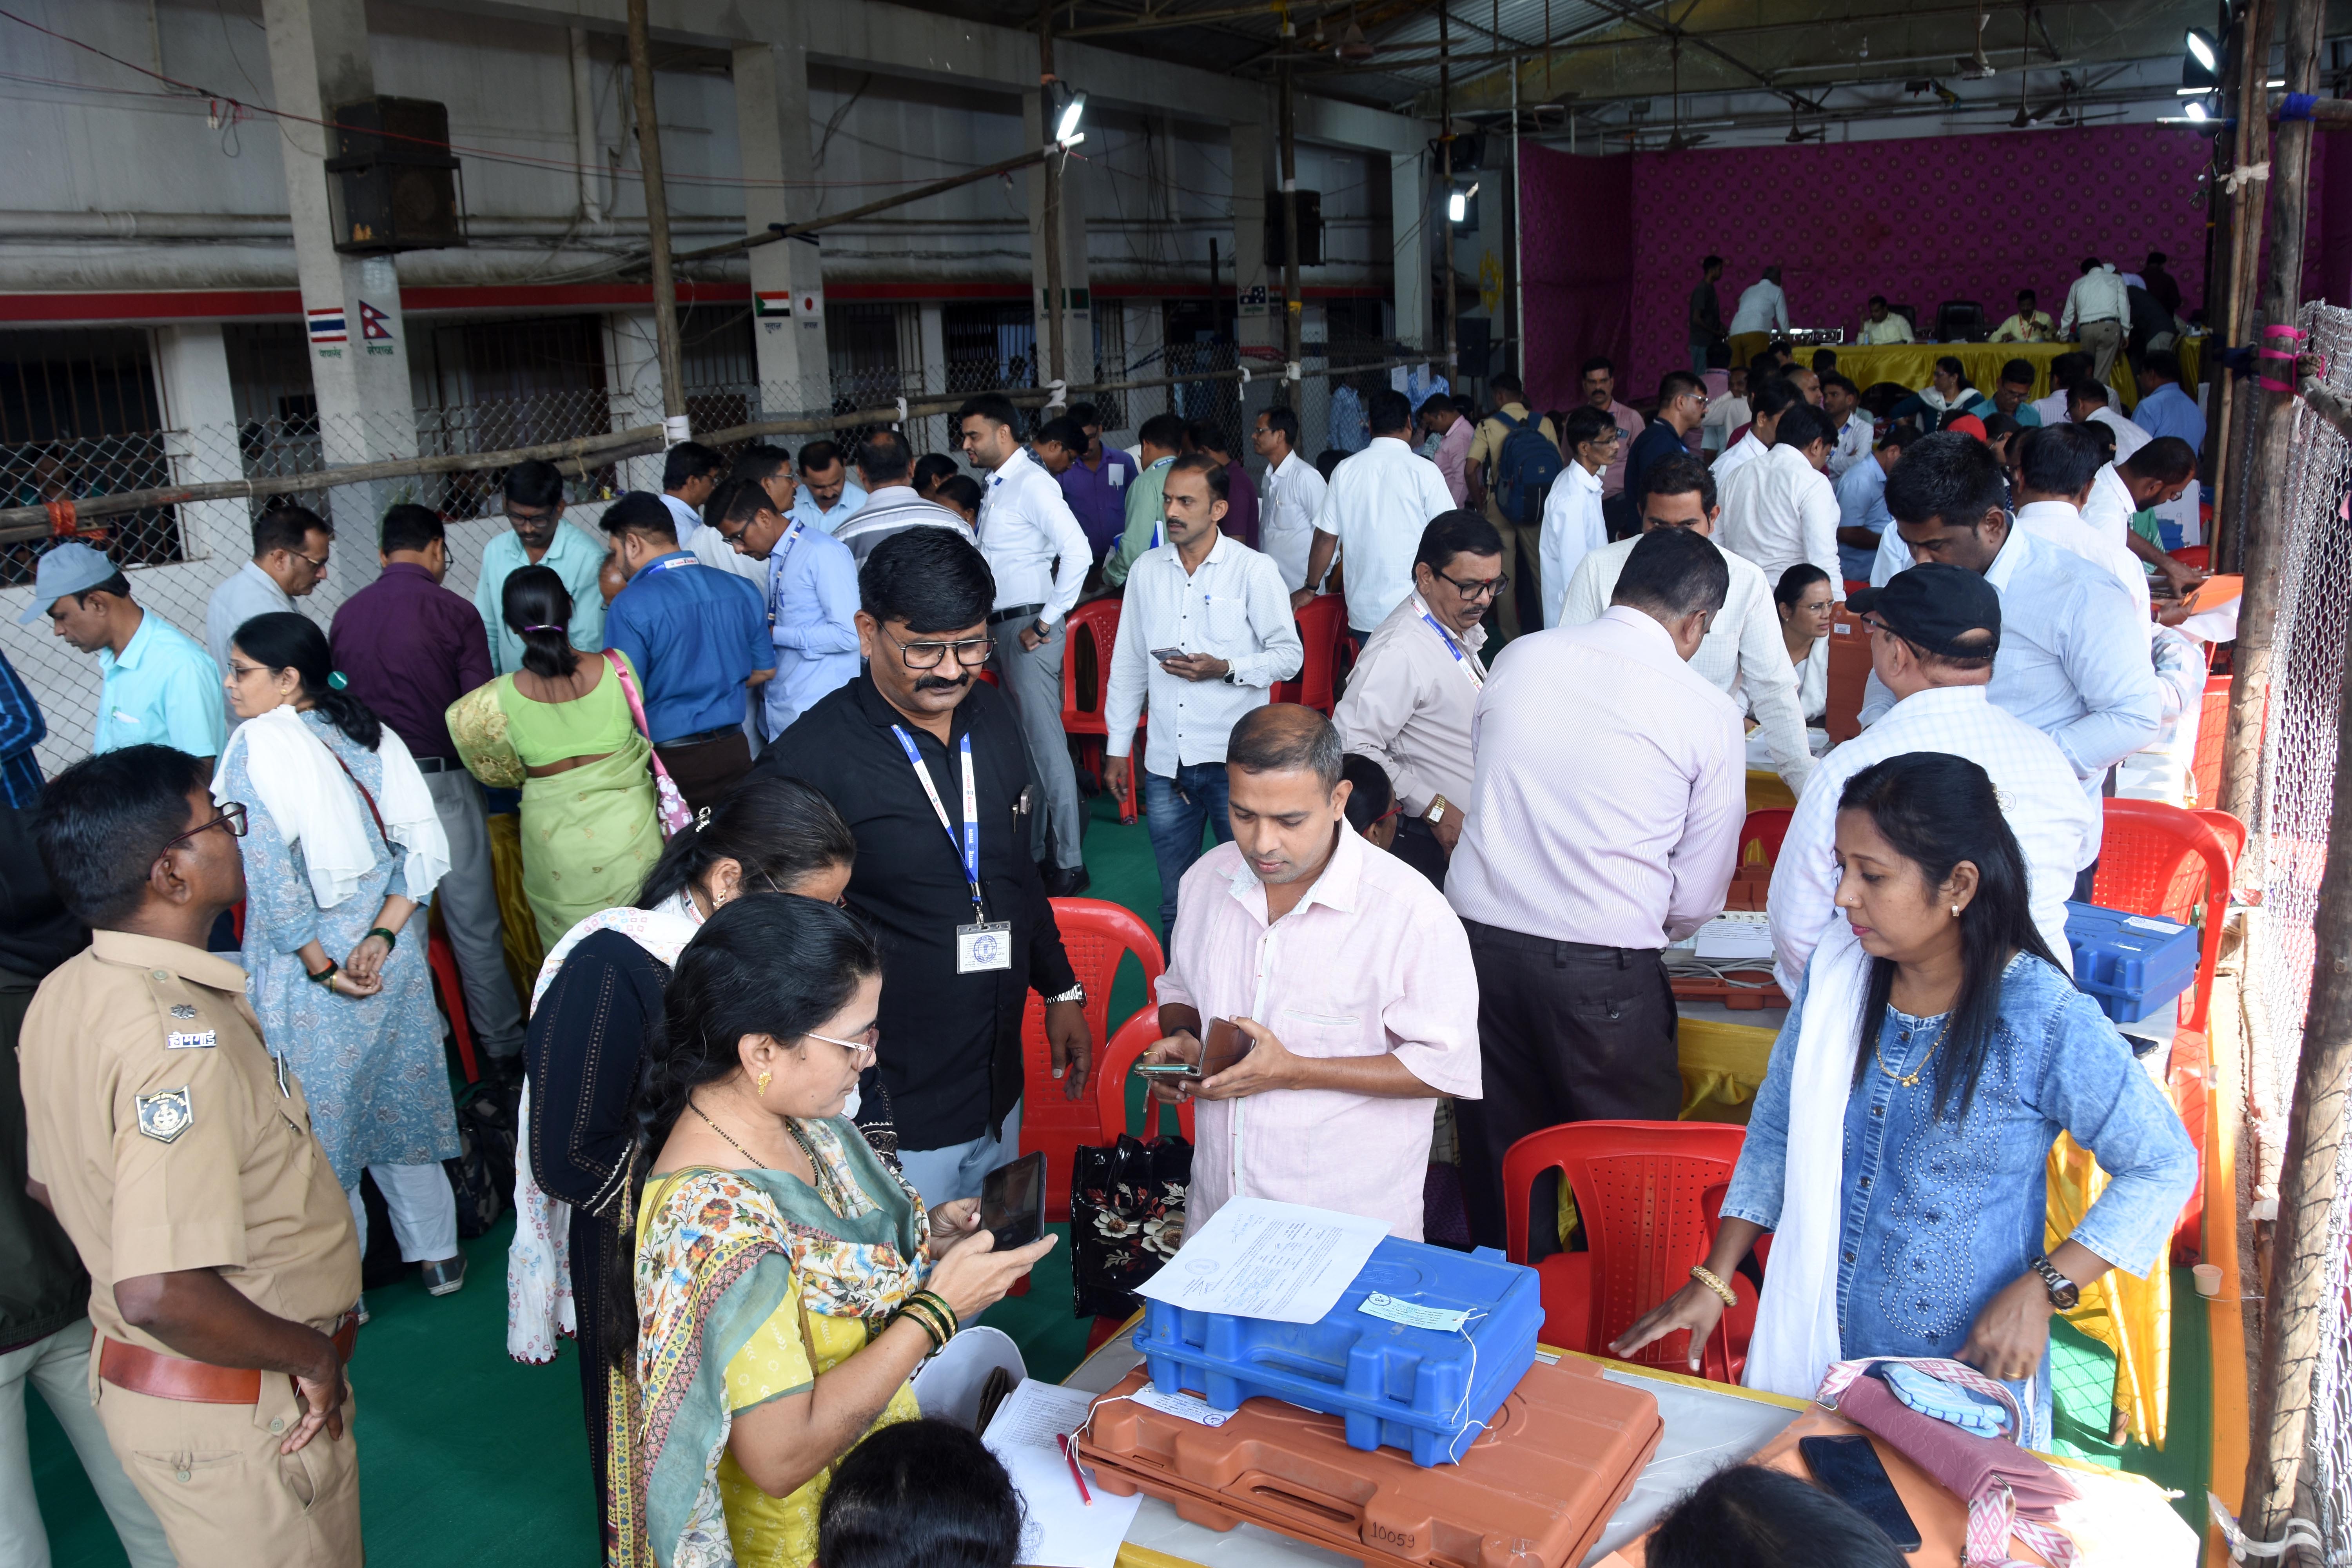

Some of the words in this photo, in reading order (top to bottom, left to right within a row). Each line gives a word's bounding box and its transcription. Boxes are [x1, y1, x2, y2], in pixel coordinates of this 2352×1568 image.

[898, 726, 913, 753] Government
[169, 1029, 216, 1046] होमगार्ड
[1370, 1521, 1416, 1548] 10059
